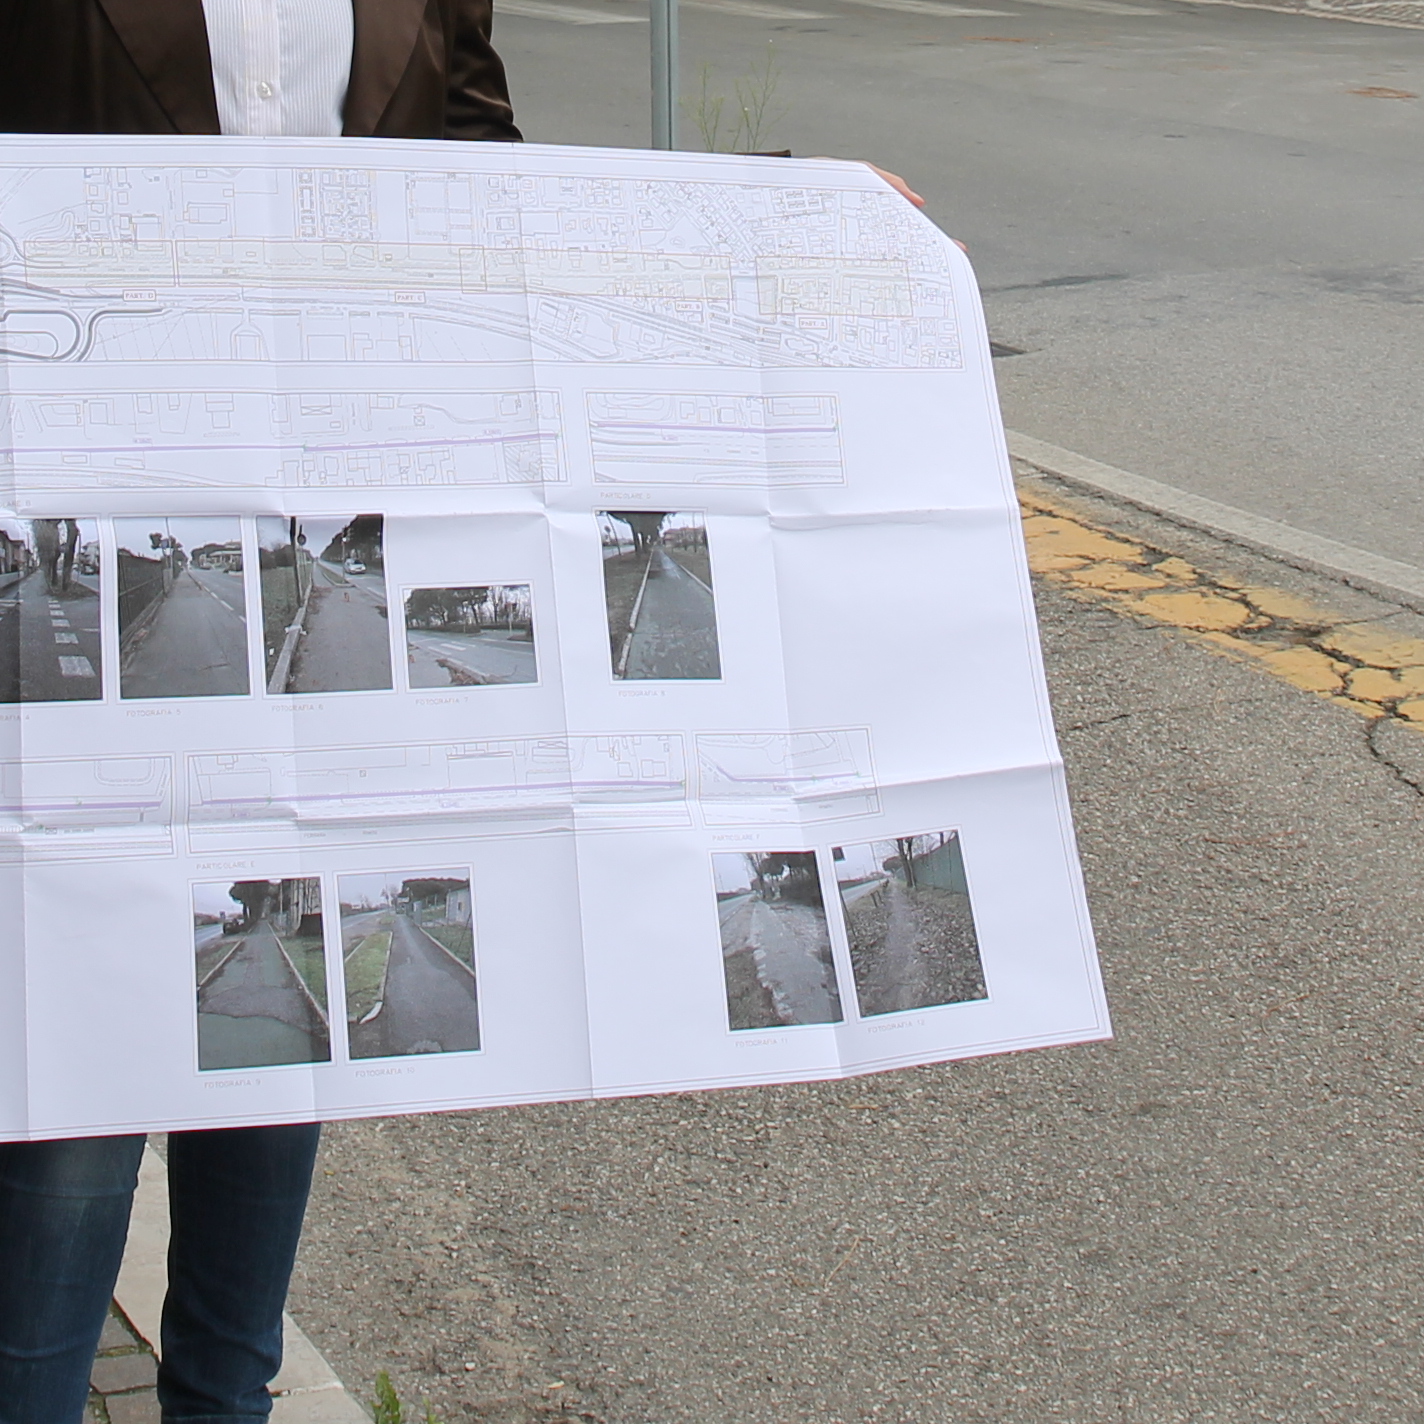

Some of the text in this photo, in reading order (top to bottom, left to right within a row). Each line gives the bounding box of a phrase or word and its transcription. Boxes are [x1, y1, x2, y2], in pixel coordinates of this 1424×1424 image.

[600, 491, 643, 499] PARTICOLARE
[415, 697, 460, 706] FOTOGRAFIA
[271, 704, 315, 712] FOTOGRAFIA
[126, 709, 172, 717] FOTOGRAFIA
[196, 861, 247, 870] PARTICOLARE
[867, 1020, 913, 1033] FOTOGRAFIA
[735, 1039, 778, 1048] FOTOGRAFIA
[355, 1068, 402, 1077] FOTOGRAFIA
[204, 1079, 252, 1088] FOTOGRAFIA
